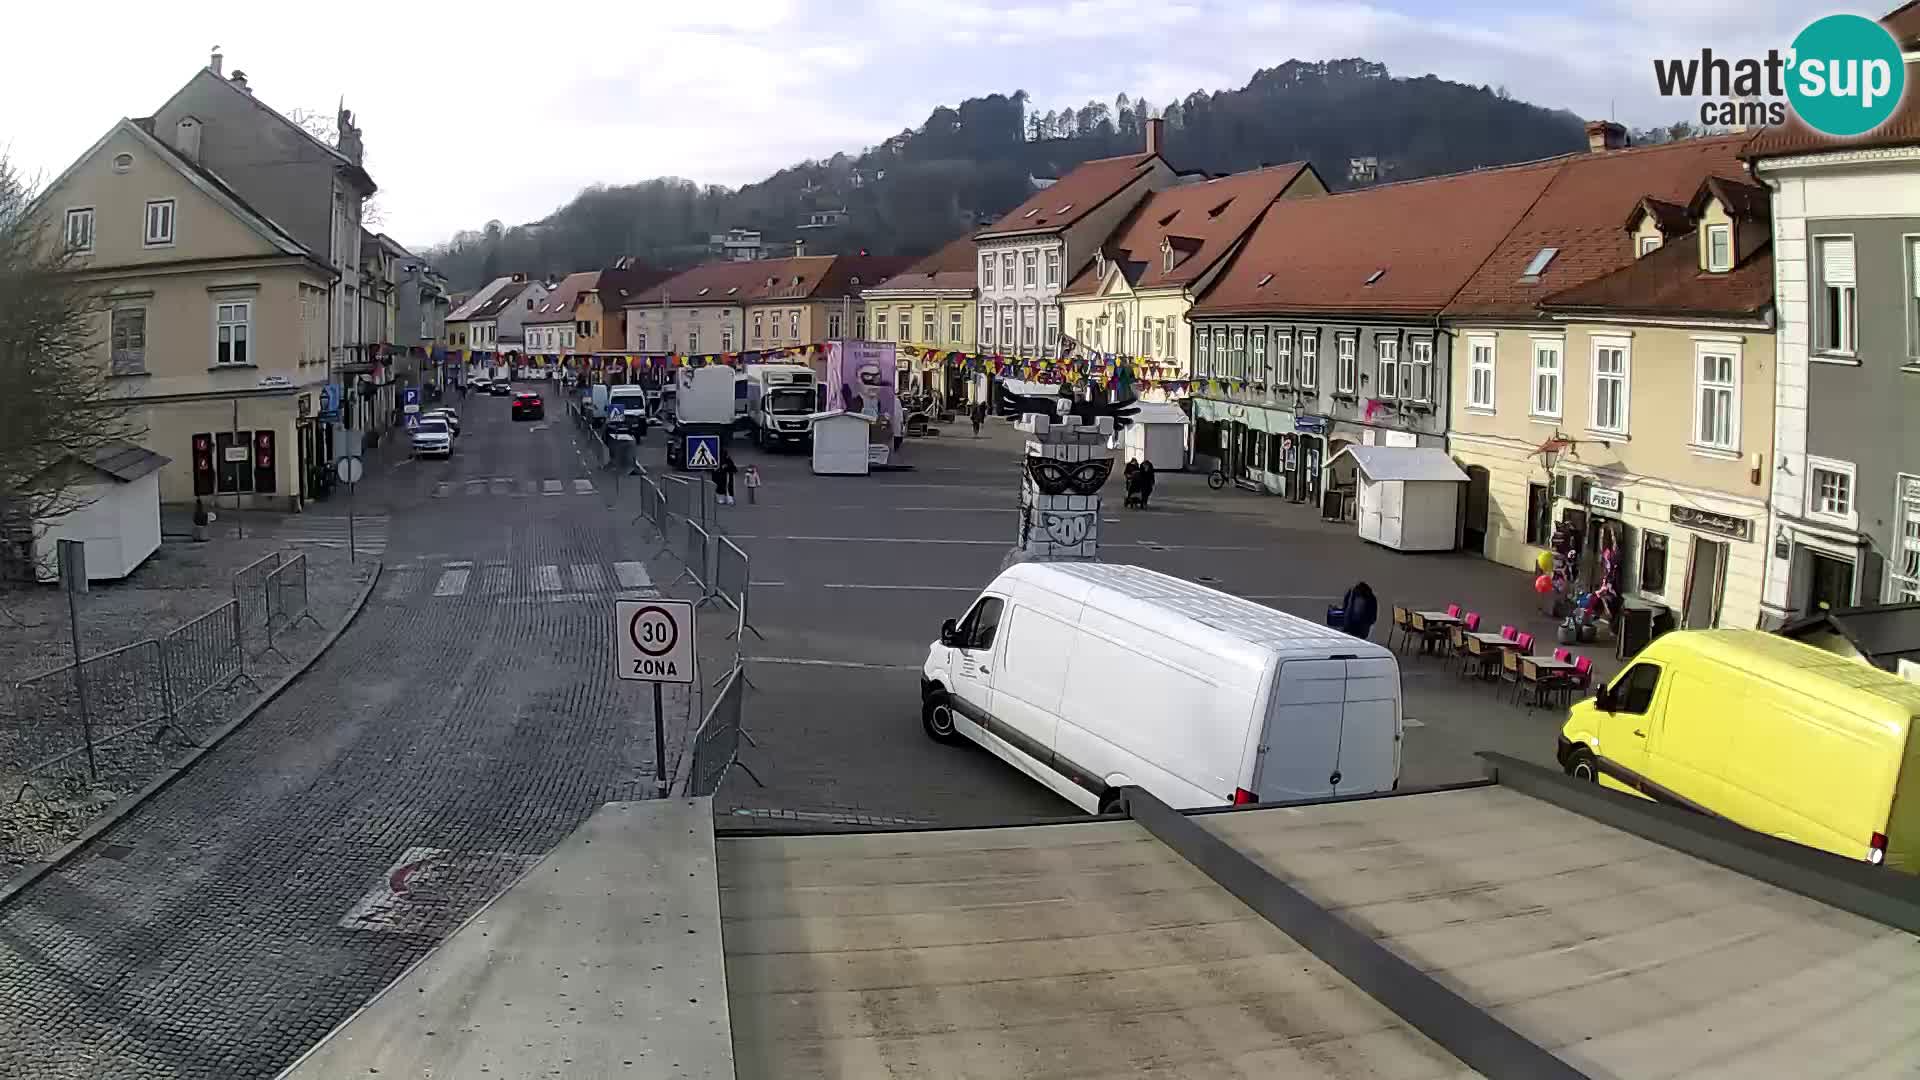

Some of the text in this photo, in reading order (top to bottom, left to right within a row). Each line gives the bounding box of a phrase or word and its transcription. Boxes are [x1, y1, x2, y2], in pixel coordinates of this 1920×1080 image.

[407, 391, 415, 403] P
[1047, 516, 1086, 545] 200
[642, 621, 667, 643] 30
[633, 659, 677, 676] ZONA
